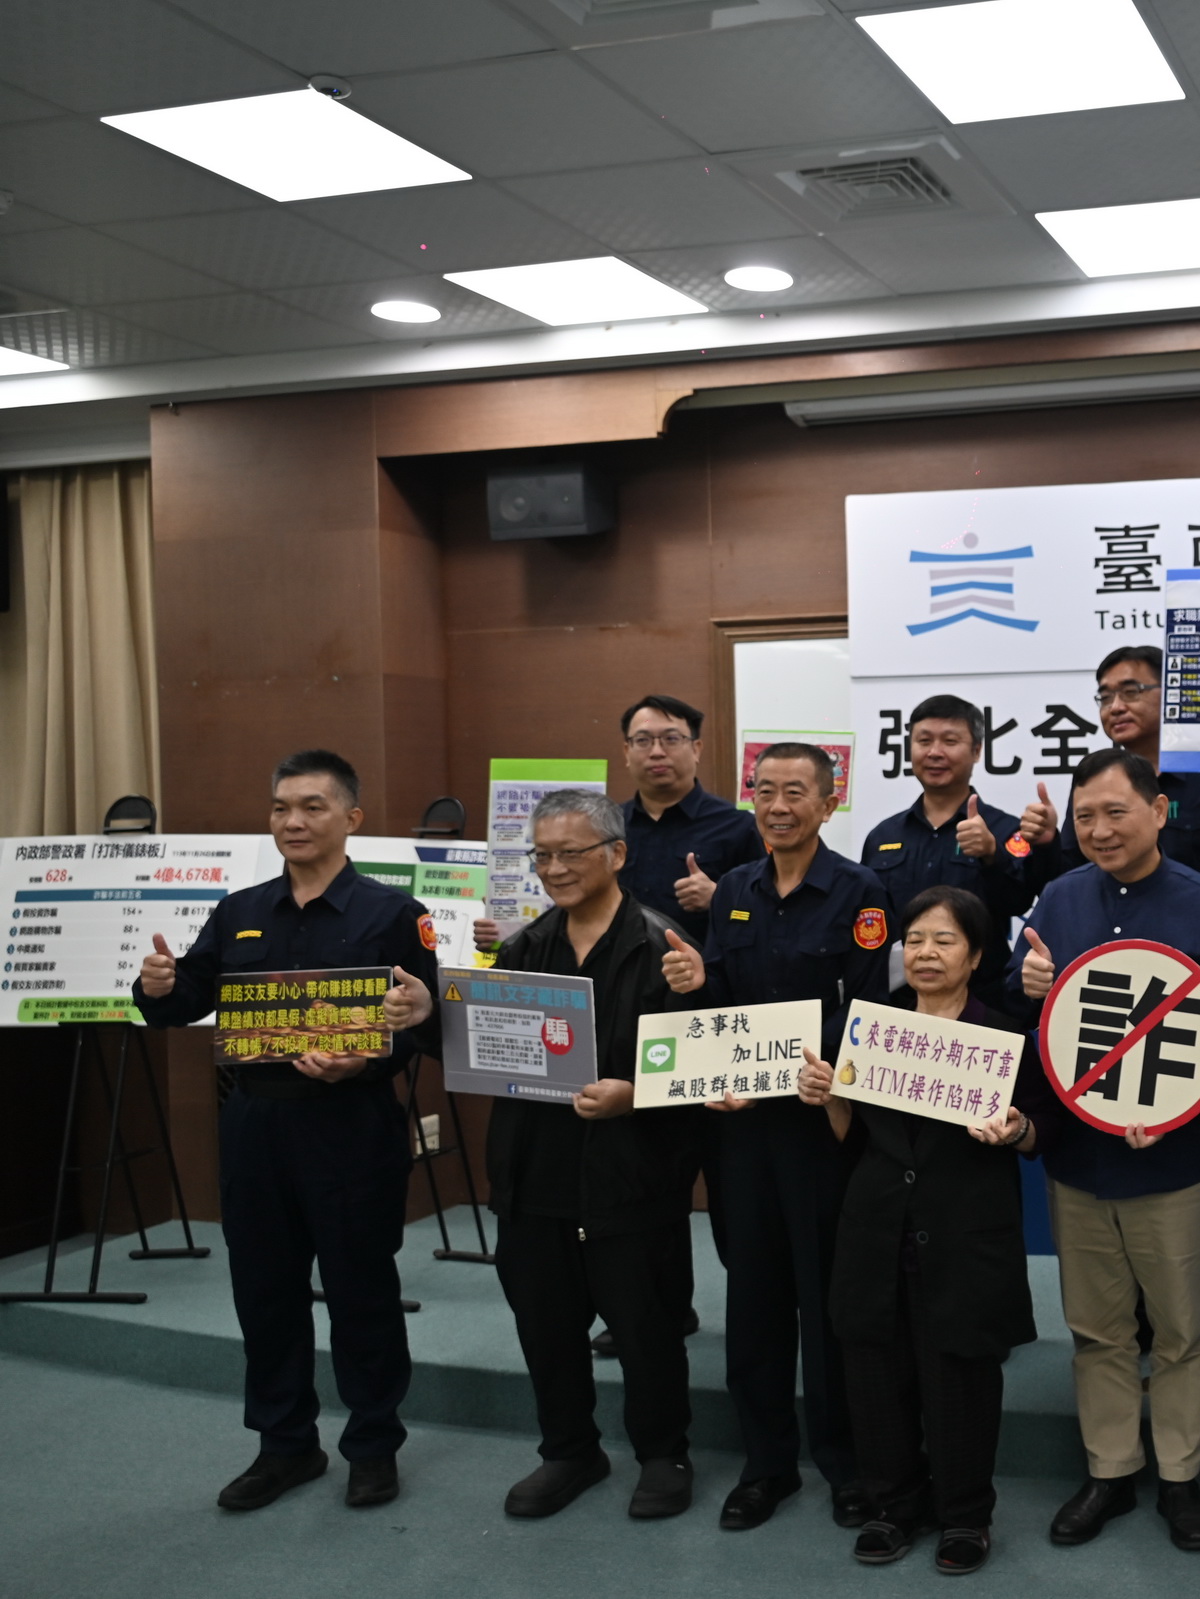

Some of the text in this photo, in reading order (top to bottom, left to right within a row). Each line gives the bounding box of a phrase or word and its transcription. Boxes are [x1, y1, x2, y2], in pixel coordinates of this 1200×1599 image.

[1094, 608, 1165, 630] Taitu
[45, 869, 68, 882] 628
[546, 1018, 569, 1046] 騙
[686, 1013, 750, 1039] 急事找
[650, 1050, 667, 1058] LINE
[864, 1020, 1014, 1079] 來電解除分期不可靠
[668, 1068, 803, 1099] 飆股群組攏係
[861, 1064, 1001, 1119] ATM操作陷阱多
